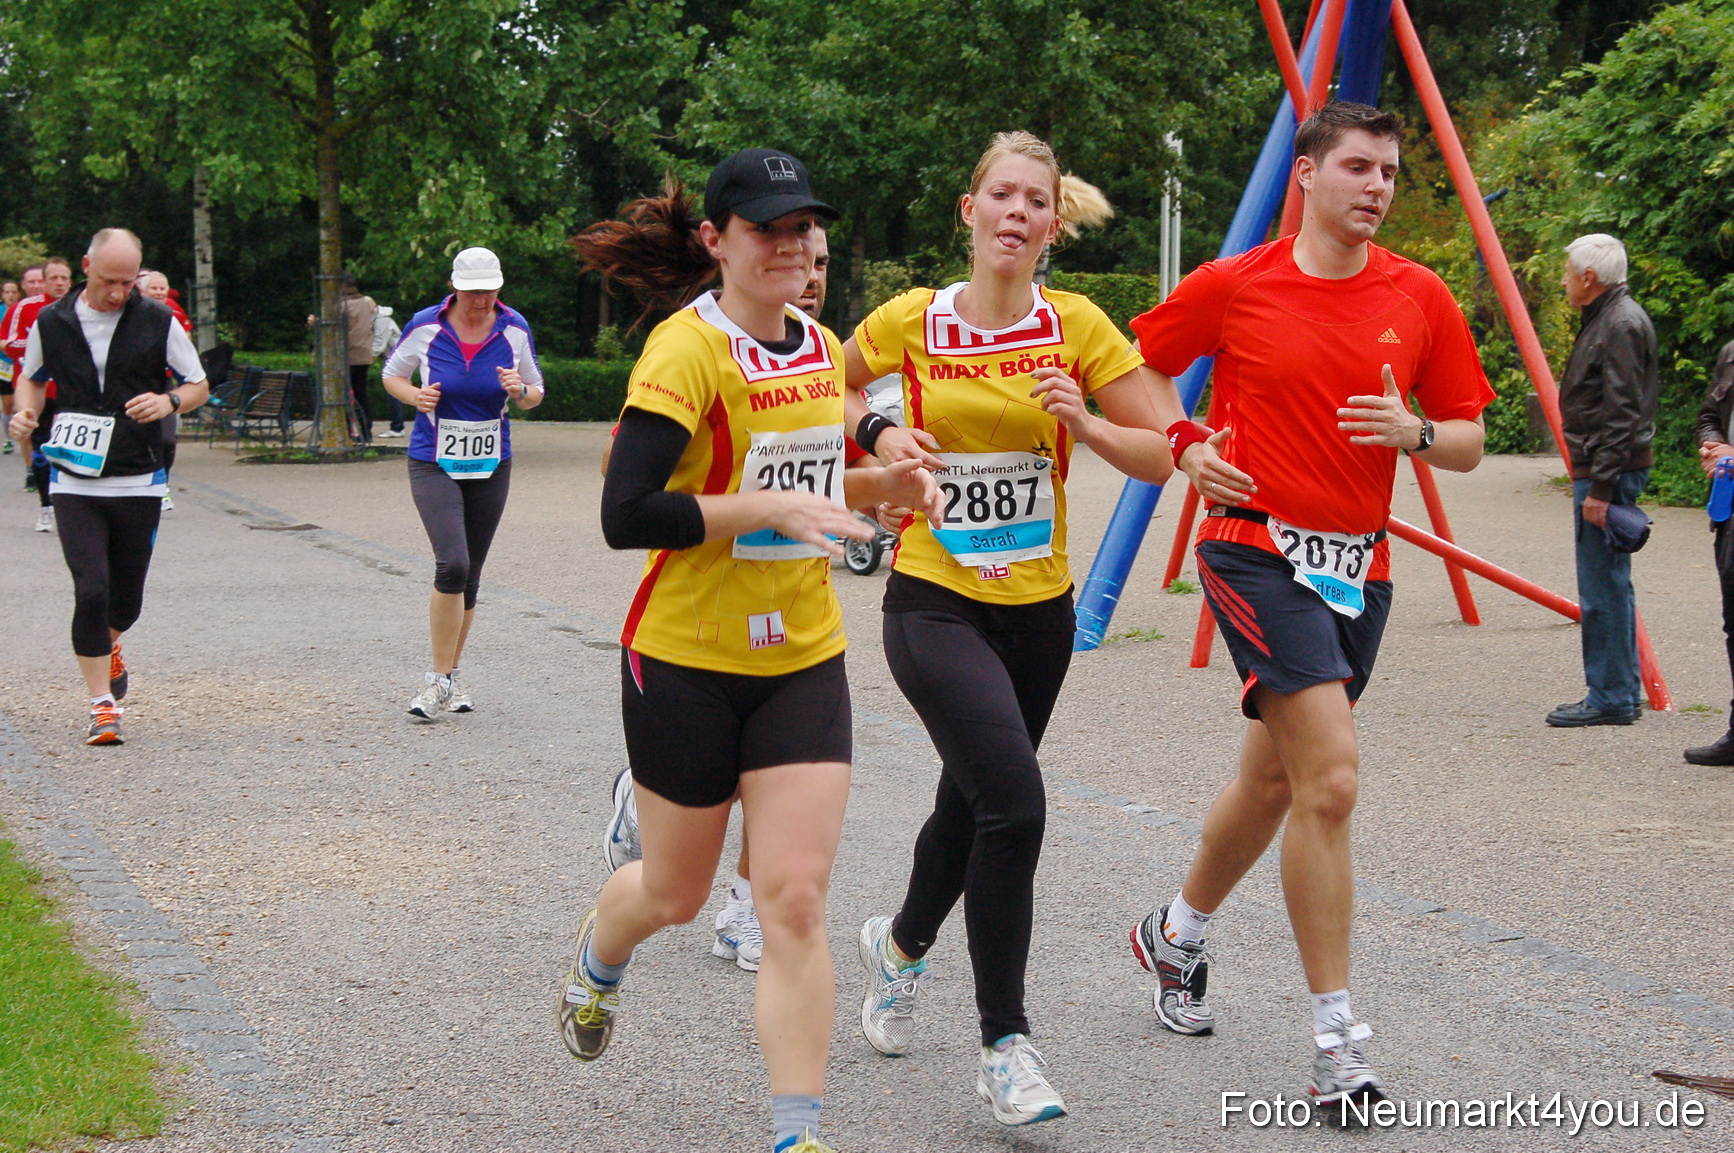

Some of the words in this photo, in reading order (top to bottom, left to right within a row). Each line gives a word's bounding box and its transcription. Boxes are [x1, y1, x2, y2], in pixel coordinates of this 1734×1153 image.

[1377, 336, 1401, 344] adidas
[929, 364, 992, 380] MAX
[999, 353, 1068, 378] BÖGL
[638, 380, 696, 412] ax-boegl.de
[748, 385, 804, 412] MAX
[803, 377, 840, 400] BÖGL
[51, 423, 102, 450] 2181
[440, 424, 462, 433] PARTL
[463, 426, 491, 434] Neumarkt
[444, 434, 495, 457] 2109
[750, 443, 786, 457] PARTL
[788, 439, 833, 454] Neumarkt
[452, 462, 485, 473] Dagmar
[757, 457, 837, 501] 2957
[935, 464, 968, 476] ARTL
[971, 461, 1029, 476] Neumarkt
[940, 476, 1039, 524] 2887
[970, 531, 1018, 549] Sarah
[1280, 529, 1365, 580] 2073
[1314, 581, 1347, 603] dreas
